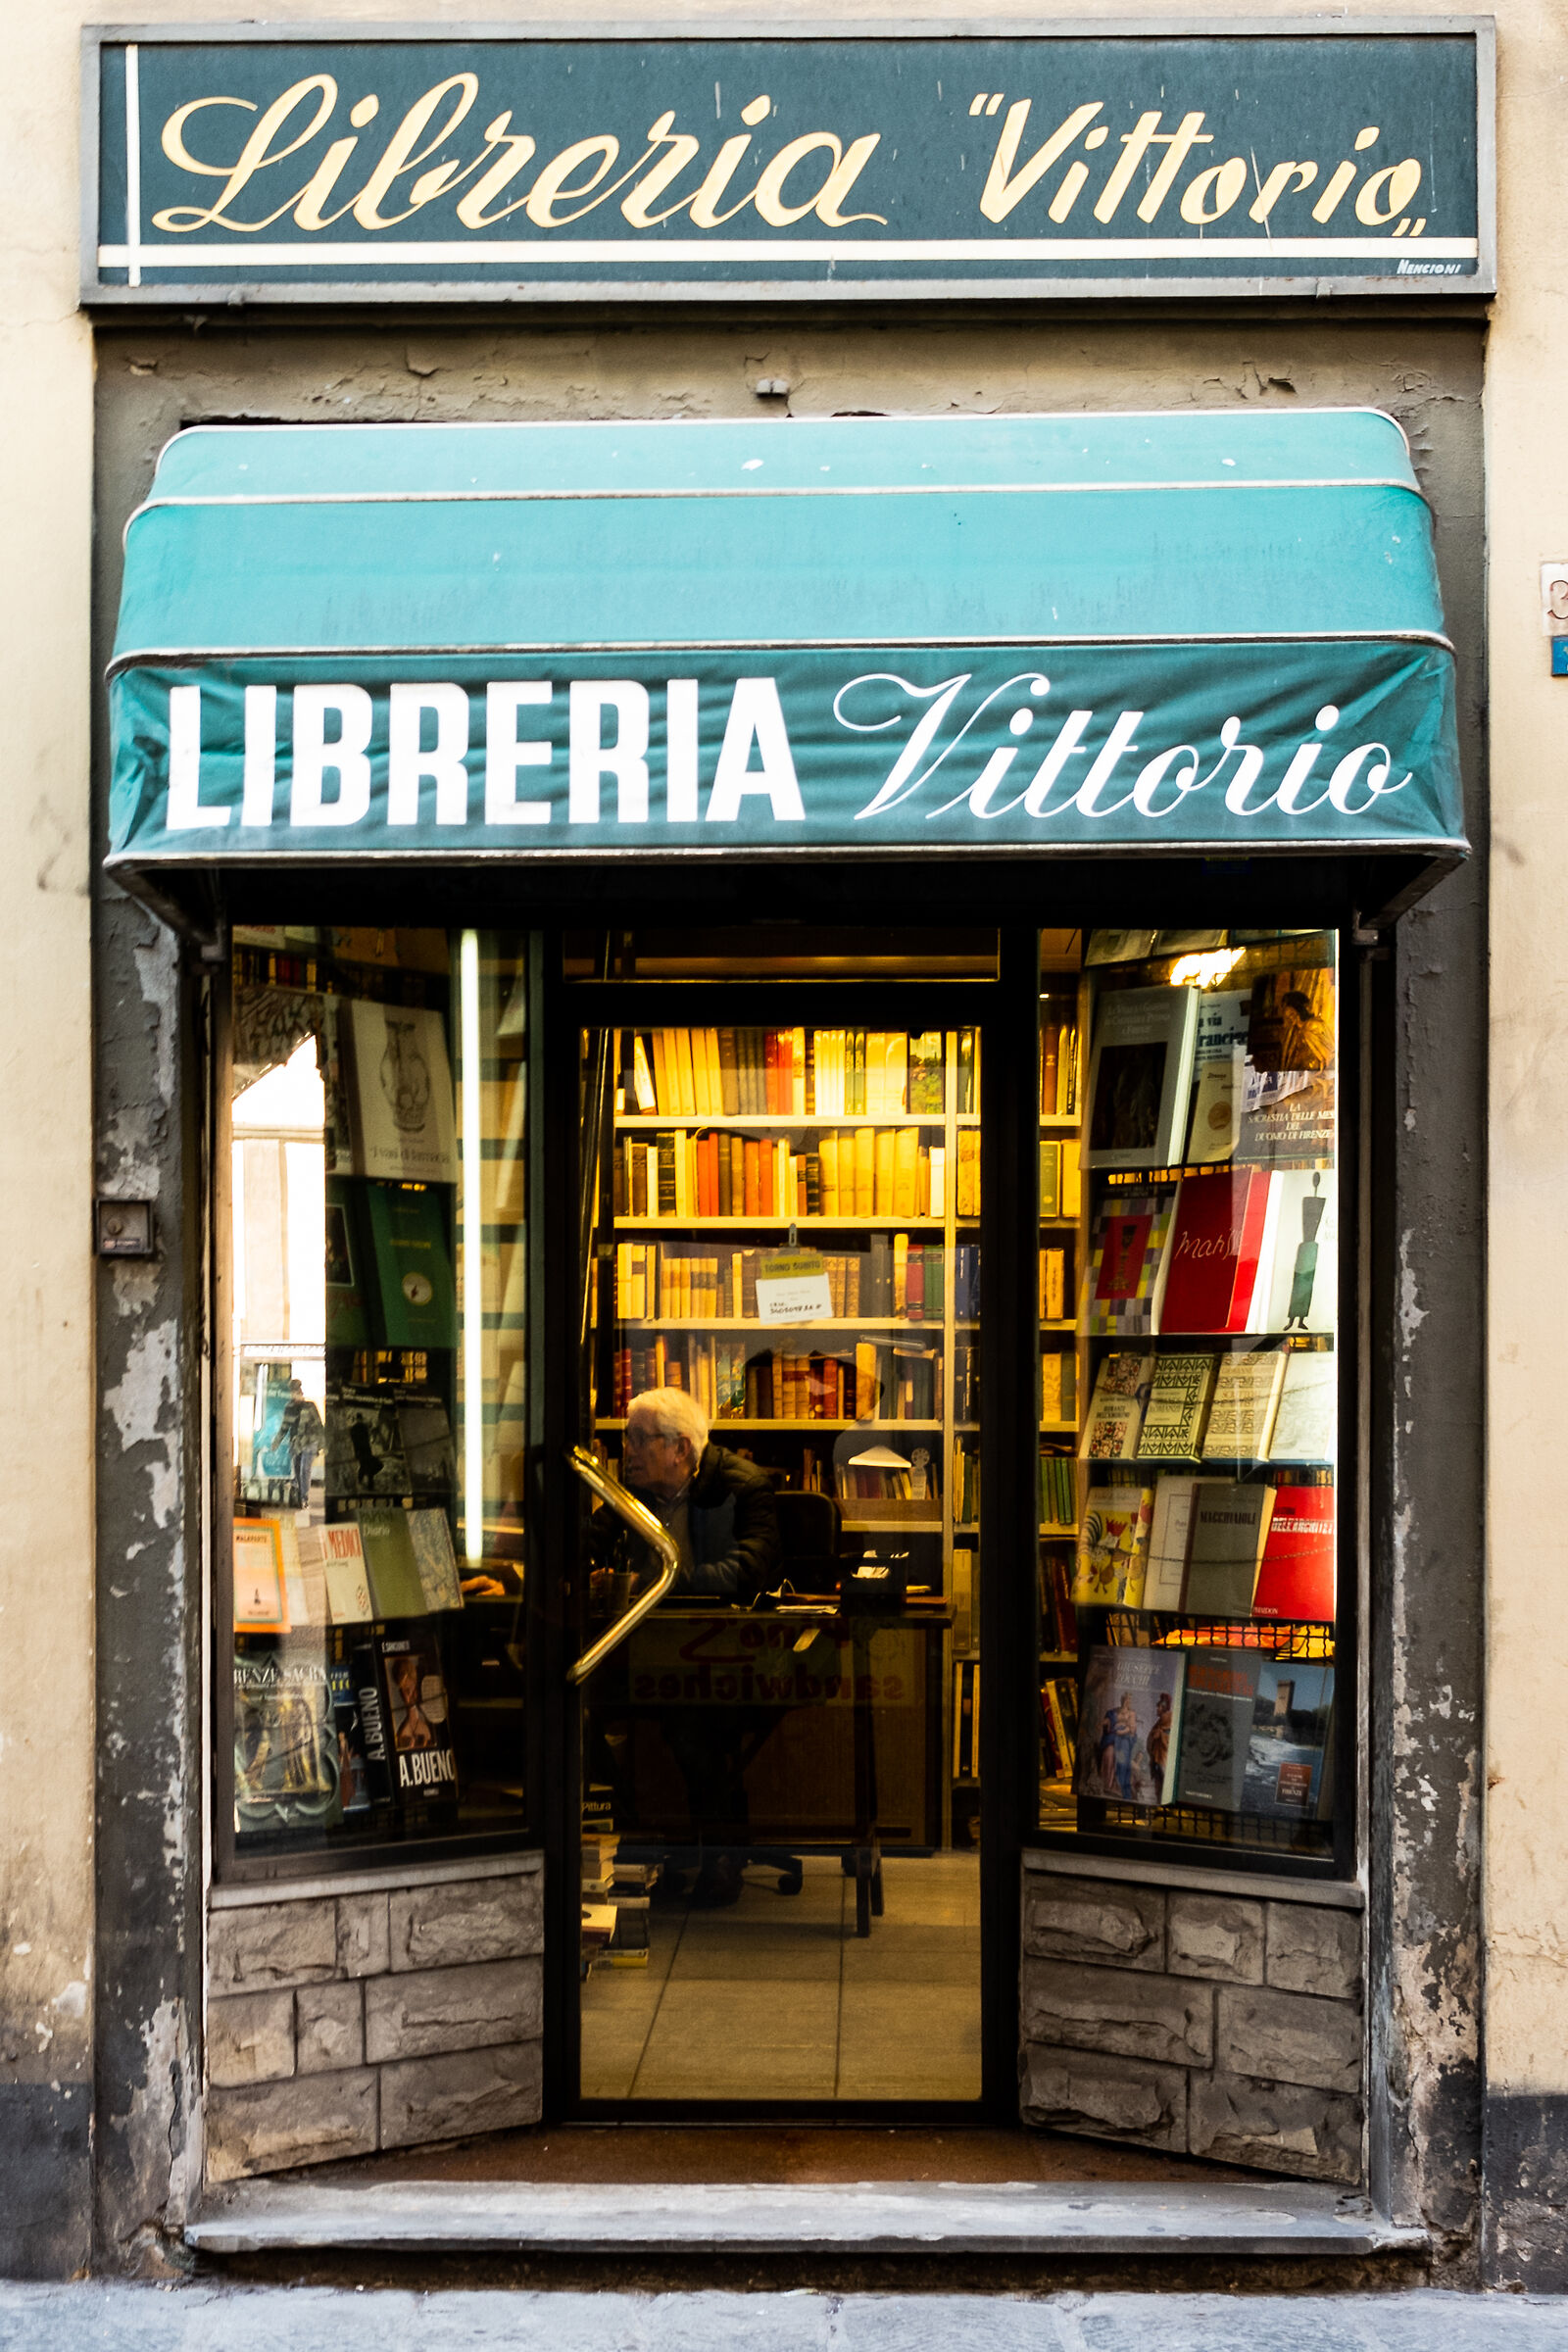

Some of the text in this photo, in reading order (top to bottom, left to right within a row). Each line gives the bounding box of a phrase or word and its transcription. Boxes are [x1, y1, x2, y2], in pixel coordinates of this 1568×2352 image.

[152, 73, 888, 232] Libreria
[166, 673, 1413, 830] LIBRERIA Vittorio
[1248, 1110, 1335, 1124] SACRESTIA DELLE MES
[1290, 1102, 1301, 1112] LA
[1254, 1129, 1334, 1142] DUOMO DI FIRENZE
[1286, 1122, 1301, 1131] DEL
[328, 1528, 363, 1559] MEDICI
[359, 1687, 386, 1761] A.BUENO
